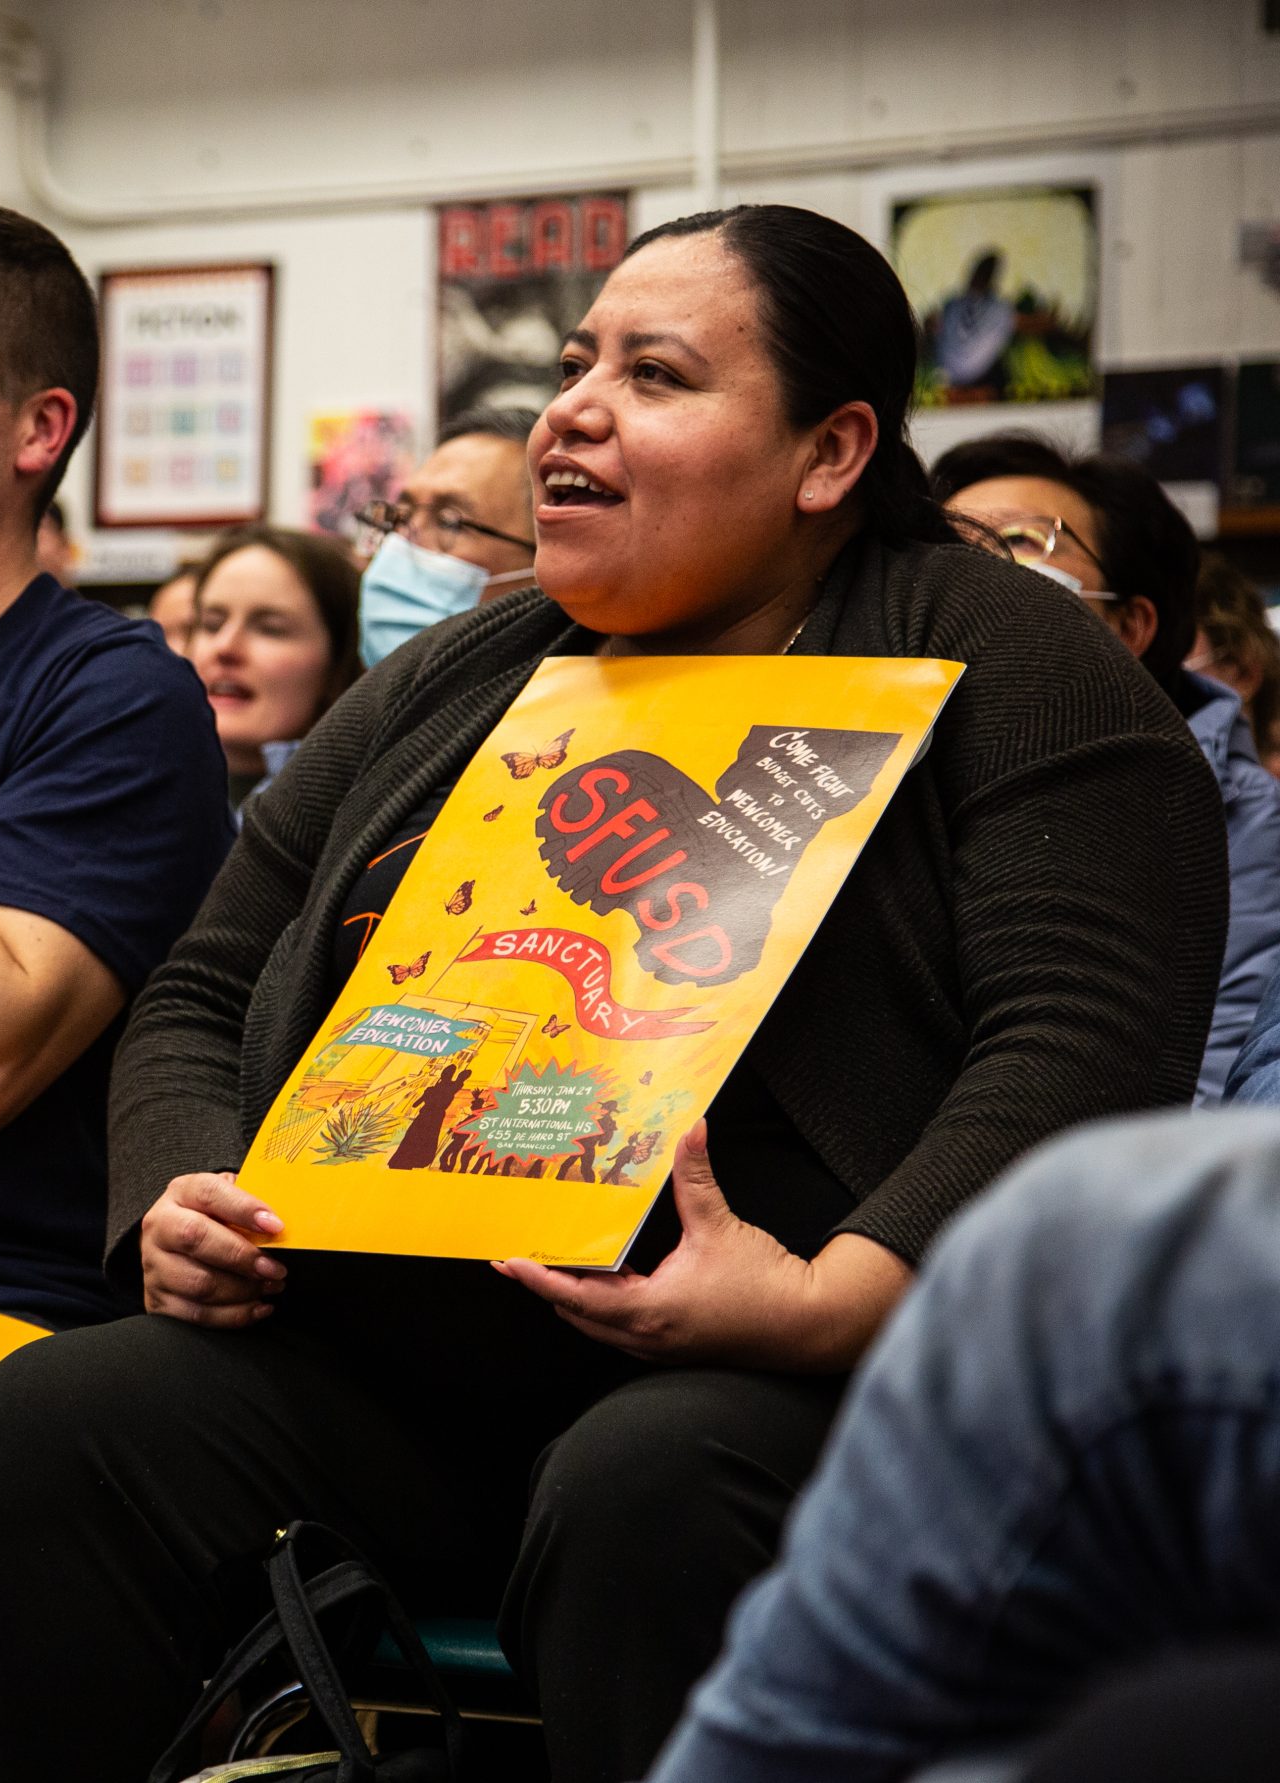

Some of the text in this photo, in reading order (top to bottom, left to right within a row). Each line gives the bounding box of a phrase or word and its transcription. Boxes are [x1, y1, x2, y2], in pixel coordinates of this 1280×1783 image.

[440, 200, 625, 277] READ
[756, 756, 826, 820] BUDGET CUTS
[769, 731, 855, 798] COME FIGHT
[725, 789, 802, 851] NEWCOMER
[768, 793, 785, 807] TO
[550, 768, 733, 977] SFUSD
[697, 811, 789, 879] EDUCATION!
[493, 933, 645, 1034] SANCTUARY
[347, 1028, 450, 1053] EDUCATION
[365, 1008, 452, 1034] NEWCOMER
[487, 1130, 512, 1140] 655
[499, 1117, 573, 1130] INTERNATIONAL
